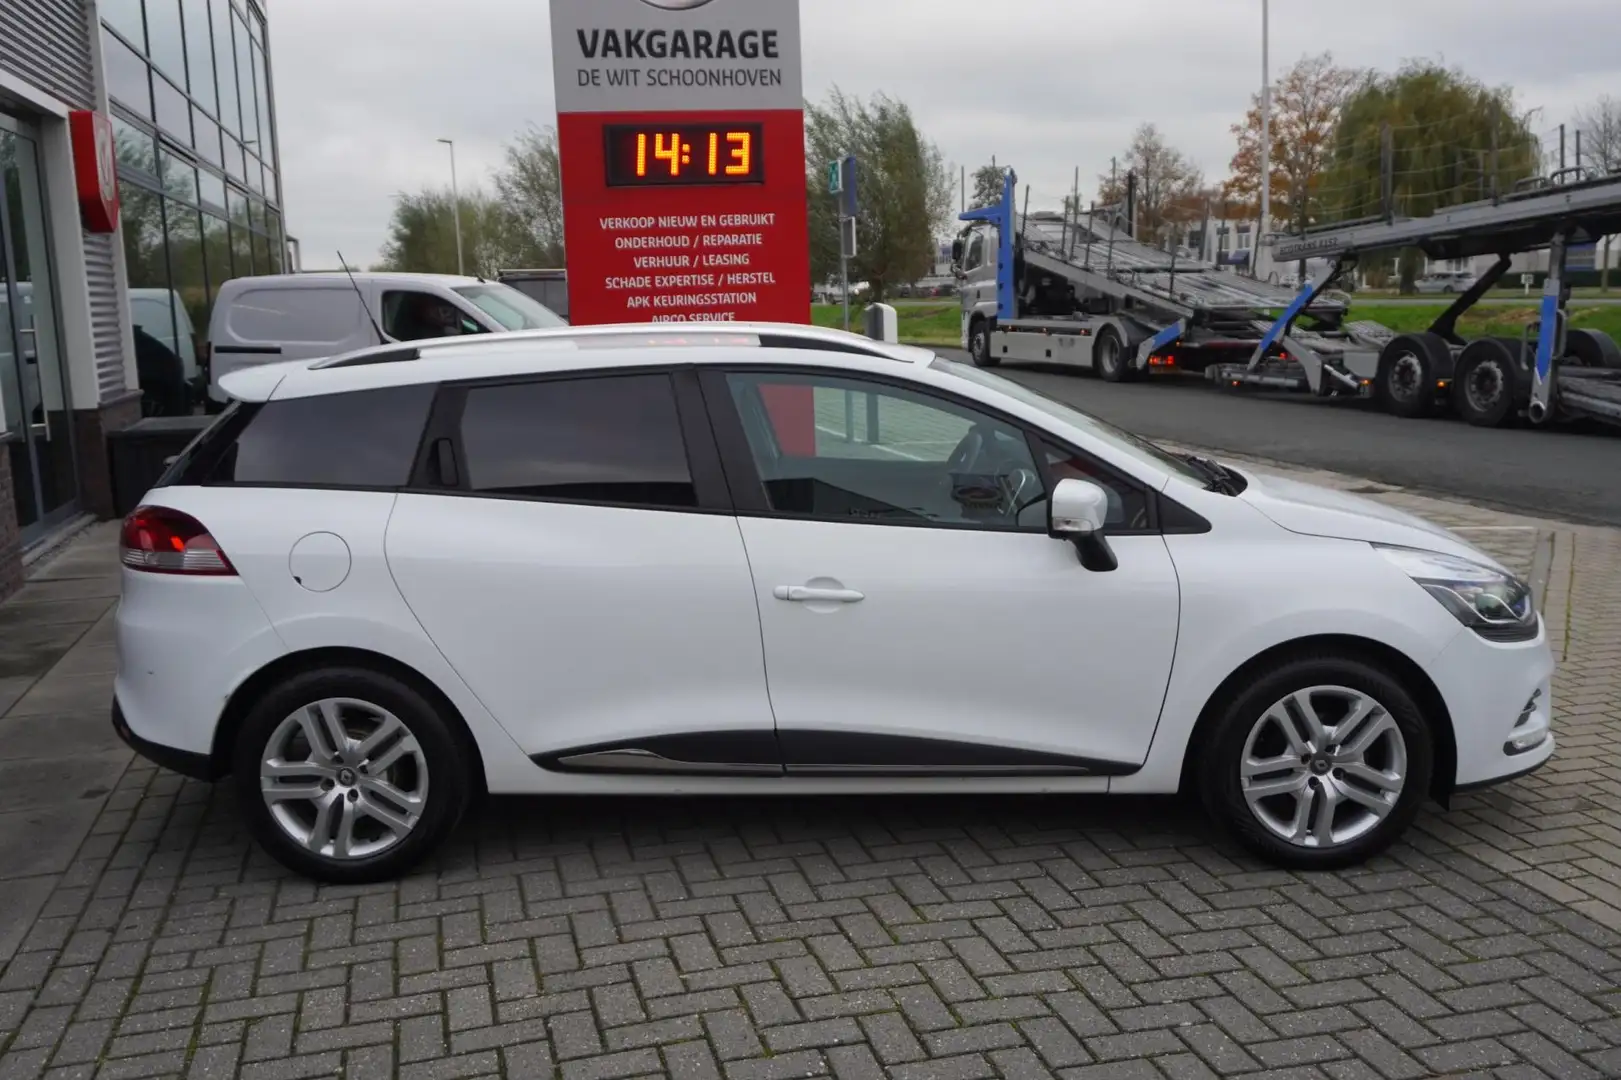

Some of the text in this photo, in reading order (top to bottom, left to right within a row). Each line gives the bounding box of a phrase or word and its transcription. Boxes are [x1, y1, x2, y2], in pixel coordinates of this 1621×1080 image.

[577, 28, 779, 58] VAKGARAGE
[578, 69, 781, 86] DE WIT SCHOONHOVEN
[637, 132, 750, 176] 14:13
[600, 213, 775, 230] VERKOOP NIEUW EN GEBRUIKT
[615, 233, 762, 249] ONDERHOUD / REPARATIE
[634, 253, 750, 268] VERHUUR / LEASING
[605, 272, 775, 289] SCHADE EXPERTISE / HERSTEL
[627, 292, 756, 308] APK KEURINGSSTATION
[689, 312, 735, 322] SERVICE
